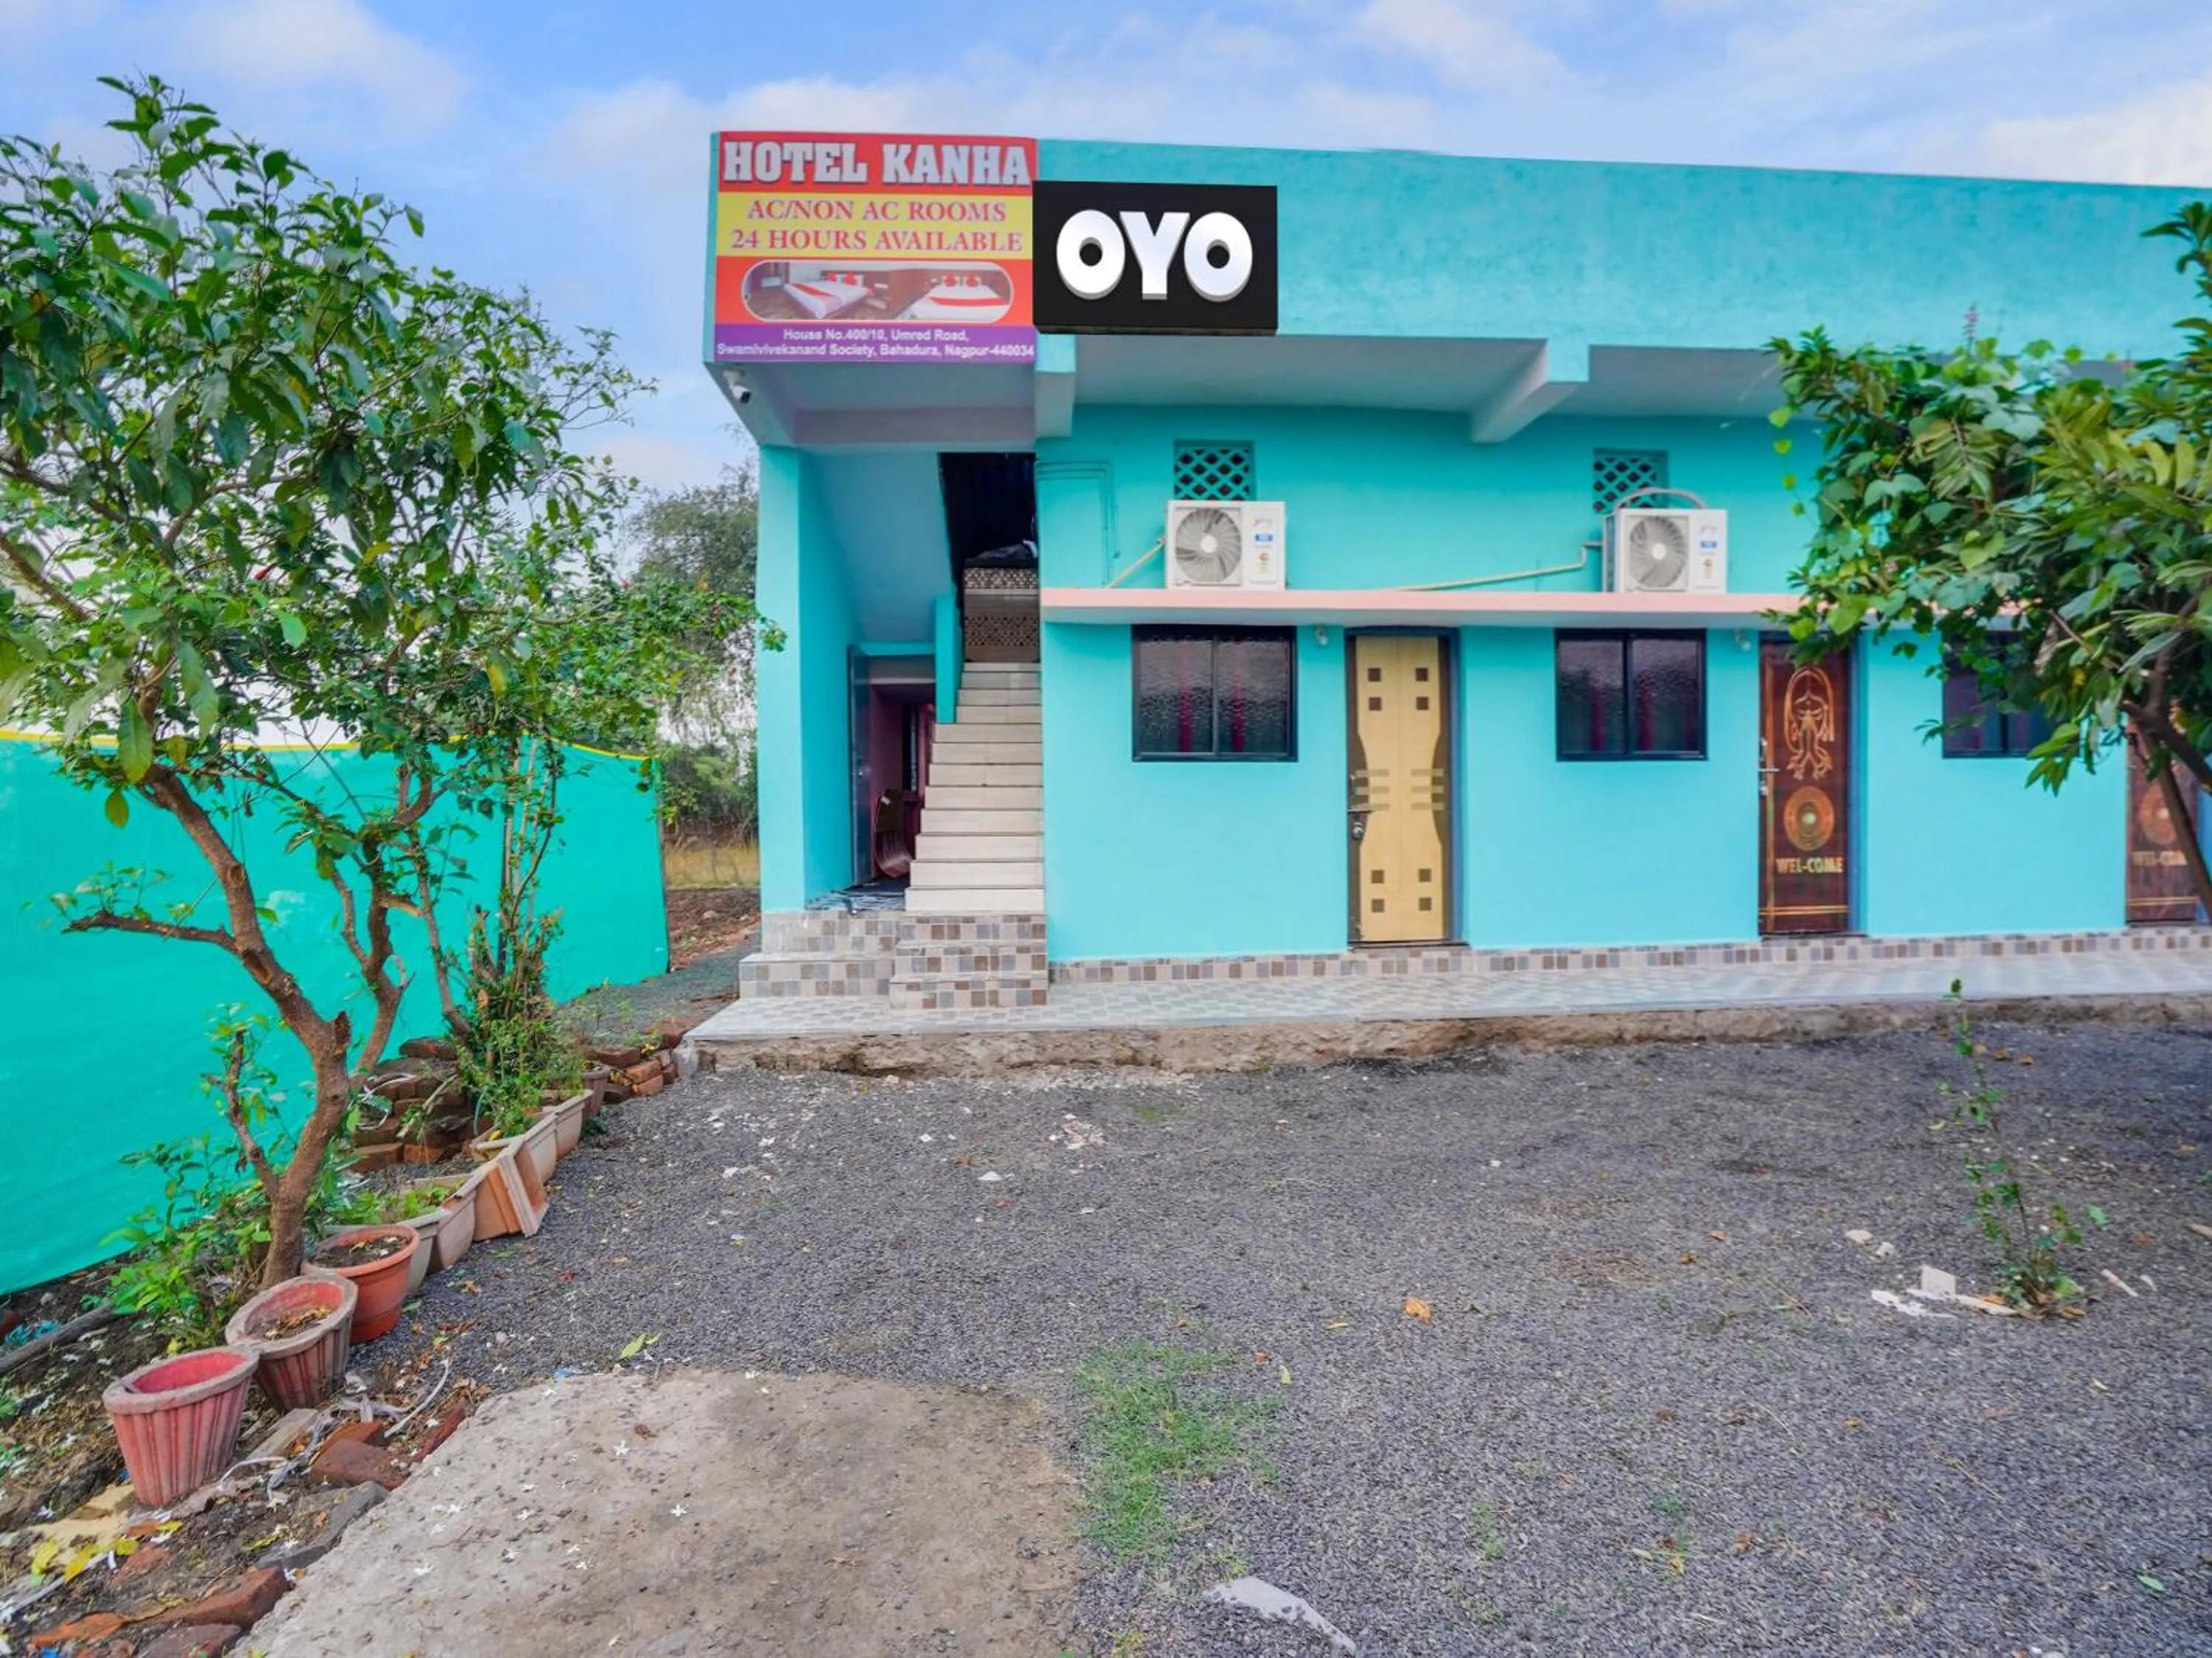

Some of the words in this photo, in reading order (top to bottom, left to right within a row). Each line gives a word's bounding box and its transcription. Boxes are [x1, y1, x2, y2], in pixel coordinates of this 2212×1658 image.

[723, 141, 868, 184] HOTEL
[883, 144, 1031, 185] KANHA
[747, 199, 854, 221] AC/NON
[862, 201, 899, 221] AC
[908, 201, 1006, 222] ROOMS
[731, 229, 760, 249] 24
[768, 229, 867, 250] HOURS
[874, 231, 1023, 252] AVAILABLE
[1057, 209, 1253, 302] OYO
[783, 328, 823, 340] House
[891, 329, 931, 341] Umred
[1776, 856, 1844, 873] WEL-COME
